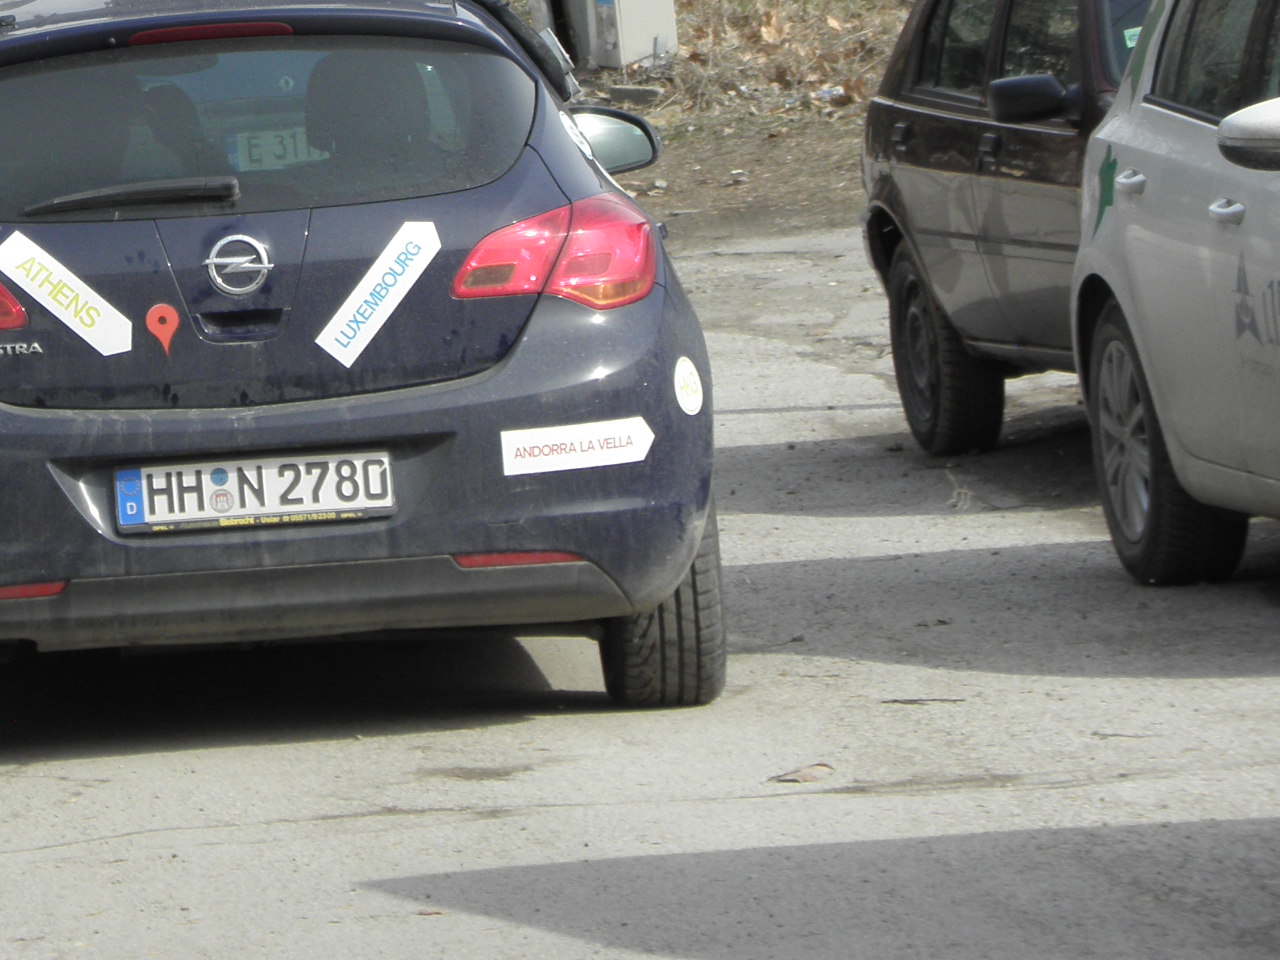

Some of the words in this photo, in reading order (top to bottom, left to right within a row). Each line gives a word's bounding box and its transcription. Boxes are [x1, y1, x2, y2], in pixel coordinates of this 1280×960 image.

[15, 256, 102, 330] ATHENS
[334, 241, 423, 349] LUXEMBOURG
[514, 441, 577, 460] ANDORRA
[579, 439, 596, 453] LA
[597, 435, 634, 451] VELLA
[126, 502, 137, 515] D
[145, 469, 206, 516] HH
[236, 464, 266, 509] N
[277, 458, 389, 506] 2780
